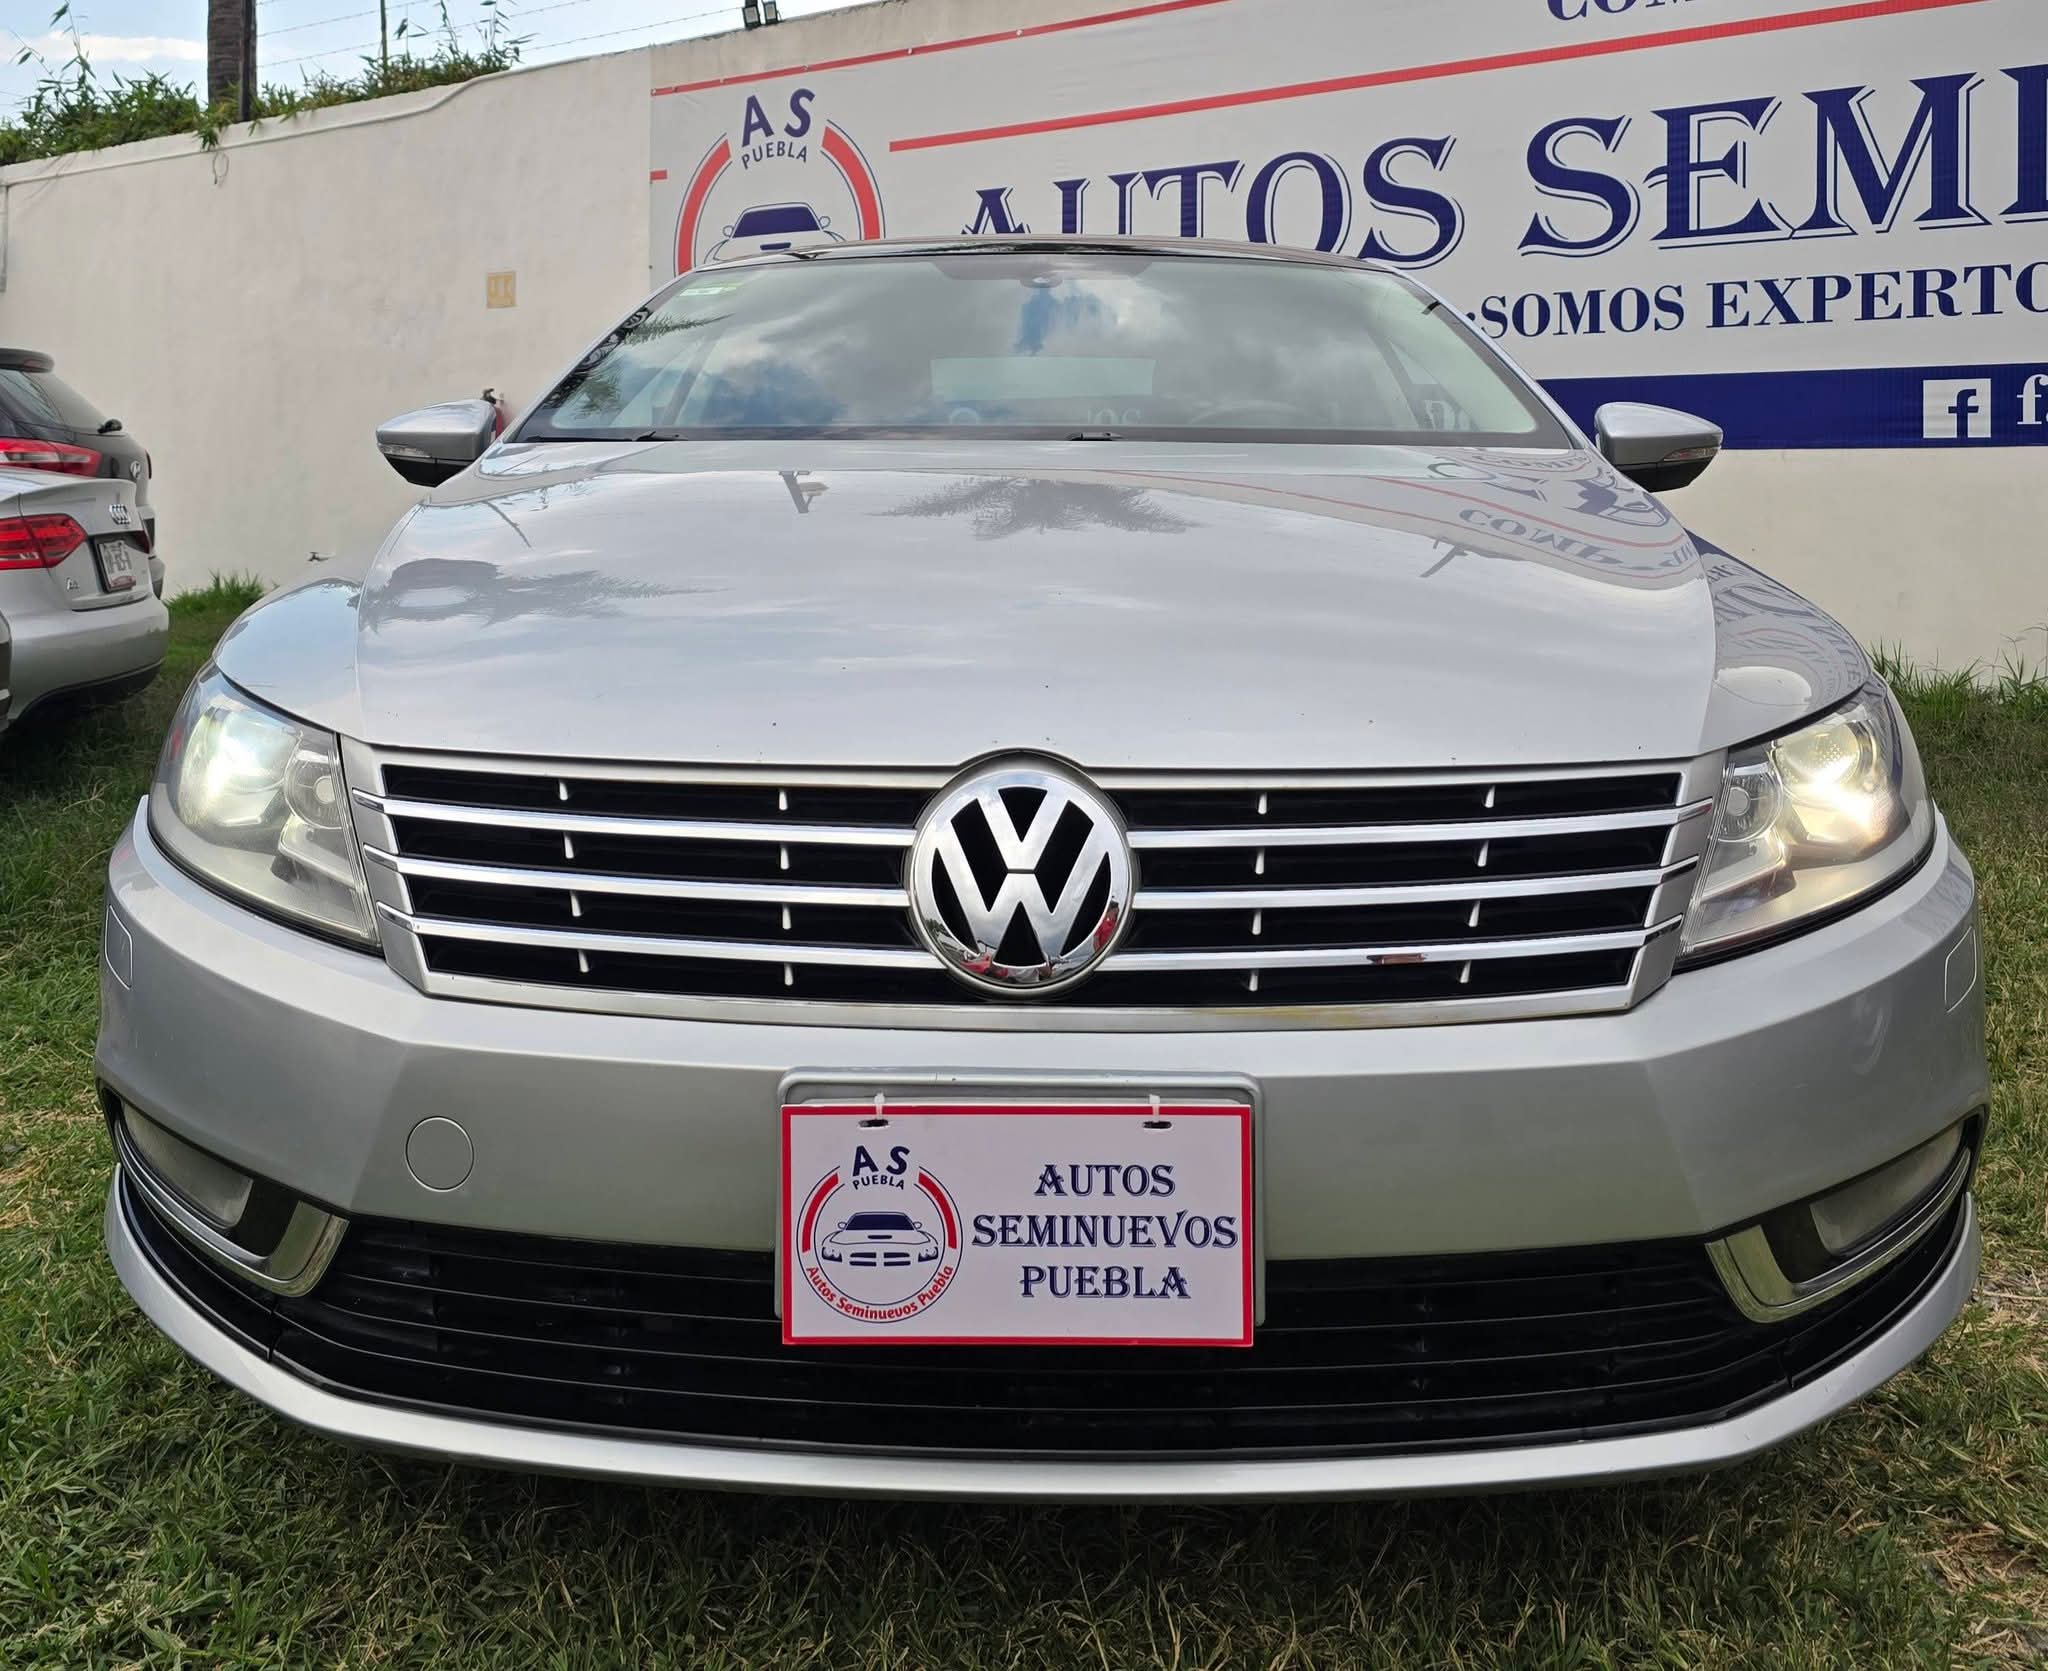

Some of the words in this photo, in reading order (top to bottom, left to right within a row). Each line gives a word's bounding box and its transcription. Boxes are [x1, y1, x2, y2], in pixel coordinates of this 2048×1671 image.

[741, 140, 807, 171] PUEBLA
[1465, 284, 1686, 339] SOMOS
[852, 1174, 906, 1191] PUEBLA
[1034, 1164, 1176, 1197] AUTOS
[972, 1209, 1239, 1249] SEMINUEVOS
[805, 1265, 838, 1302] Autos
[836, 1296, 918, 1321] Seminuevos
[917, 1264, 954, 1307] Puebla
[1020, 1265, 1191, 1299] PUEBLA
